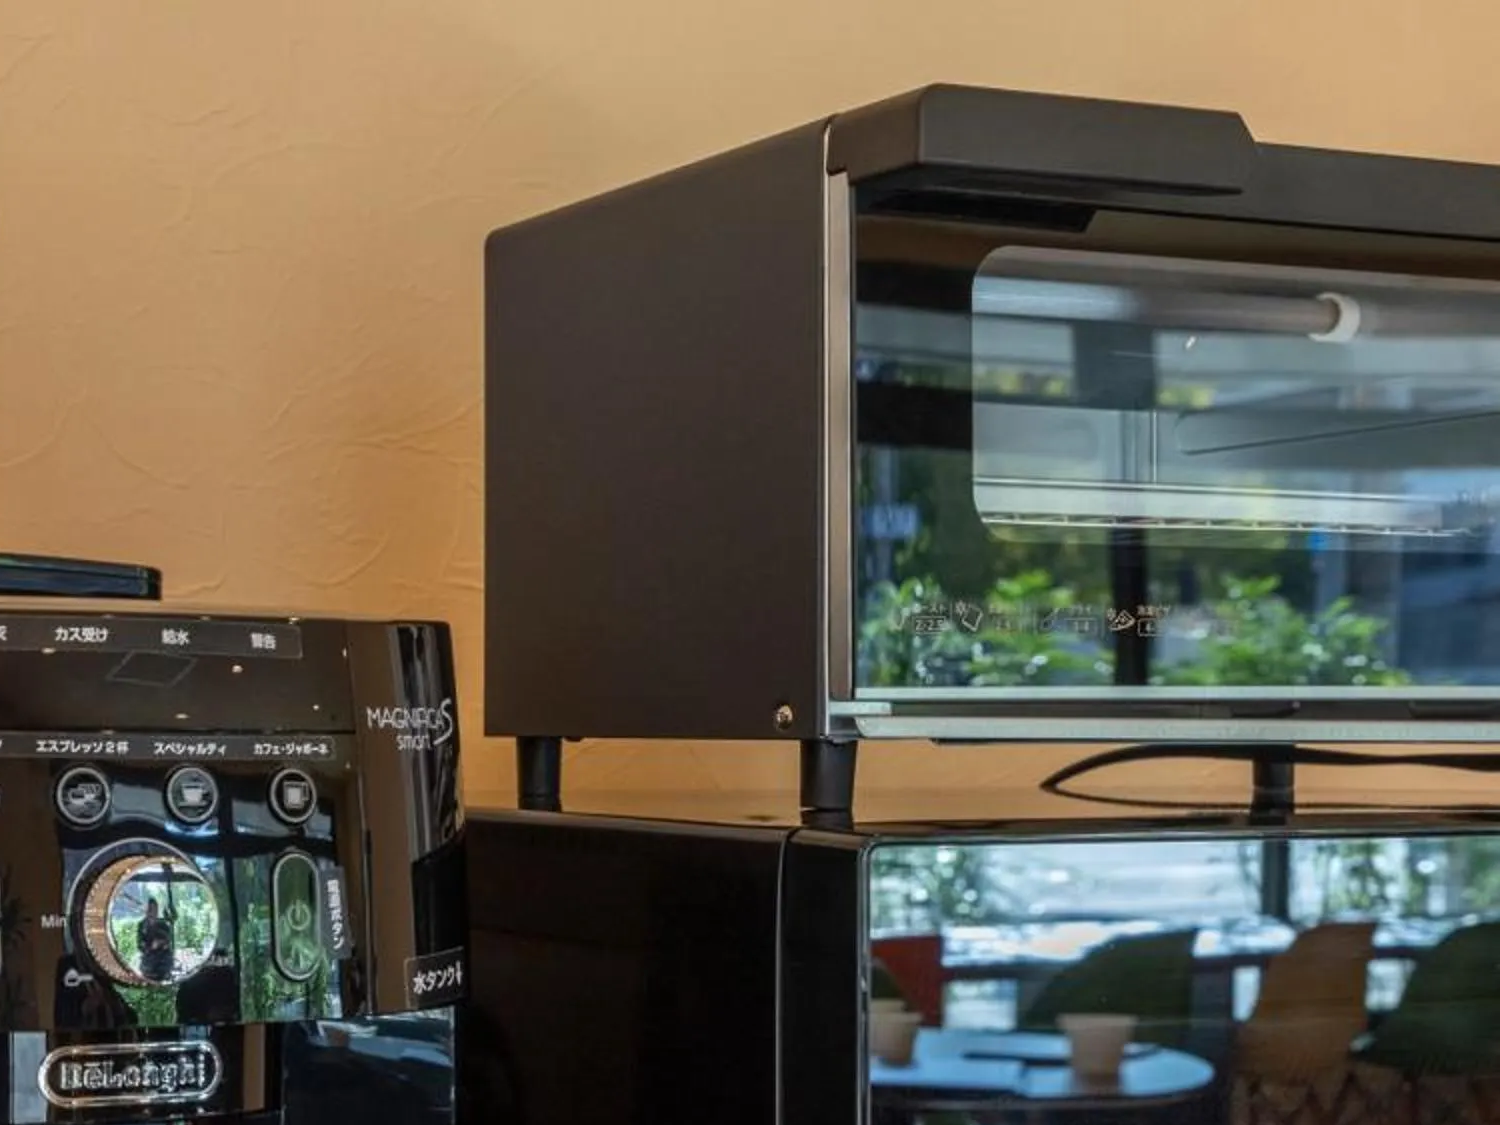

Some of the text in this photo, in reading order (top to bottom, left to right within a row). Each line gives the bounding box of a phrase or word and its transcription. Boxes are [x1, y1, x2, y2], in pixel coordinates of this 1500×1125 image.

[55, 625, 109, 643] カス受け
[161, 628, 190, 646] 給水
[250, 632, 277, 650] 警告
[153, 741, 228, 756] スペシャルティ
[41, 915, 67, 929] Min
[413, 964, 456, 995] 水タンク
